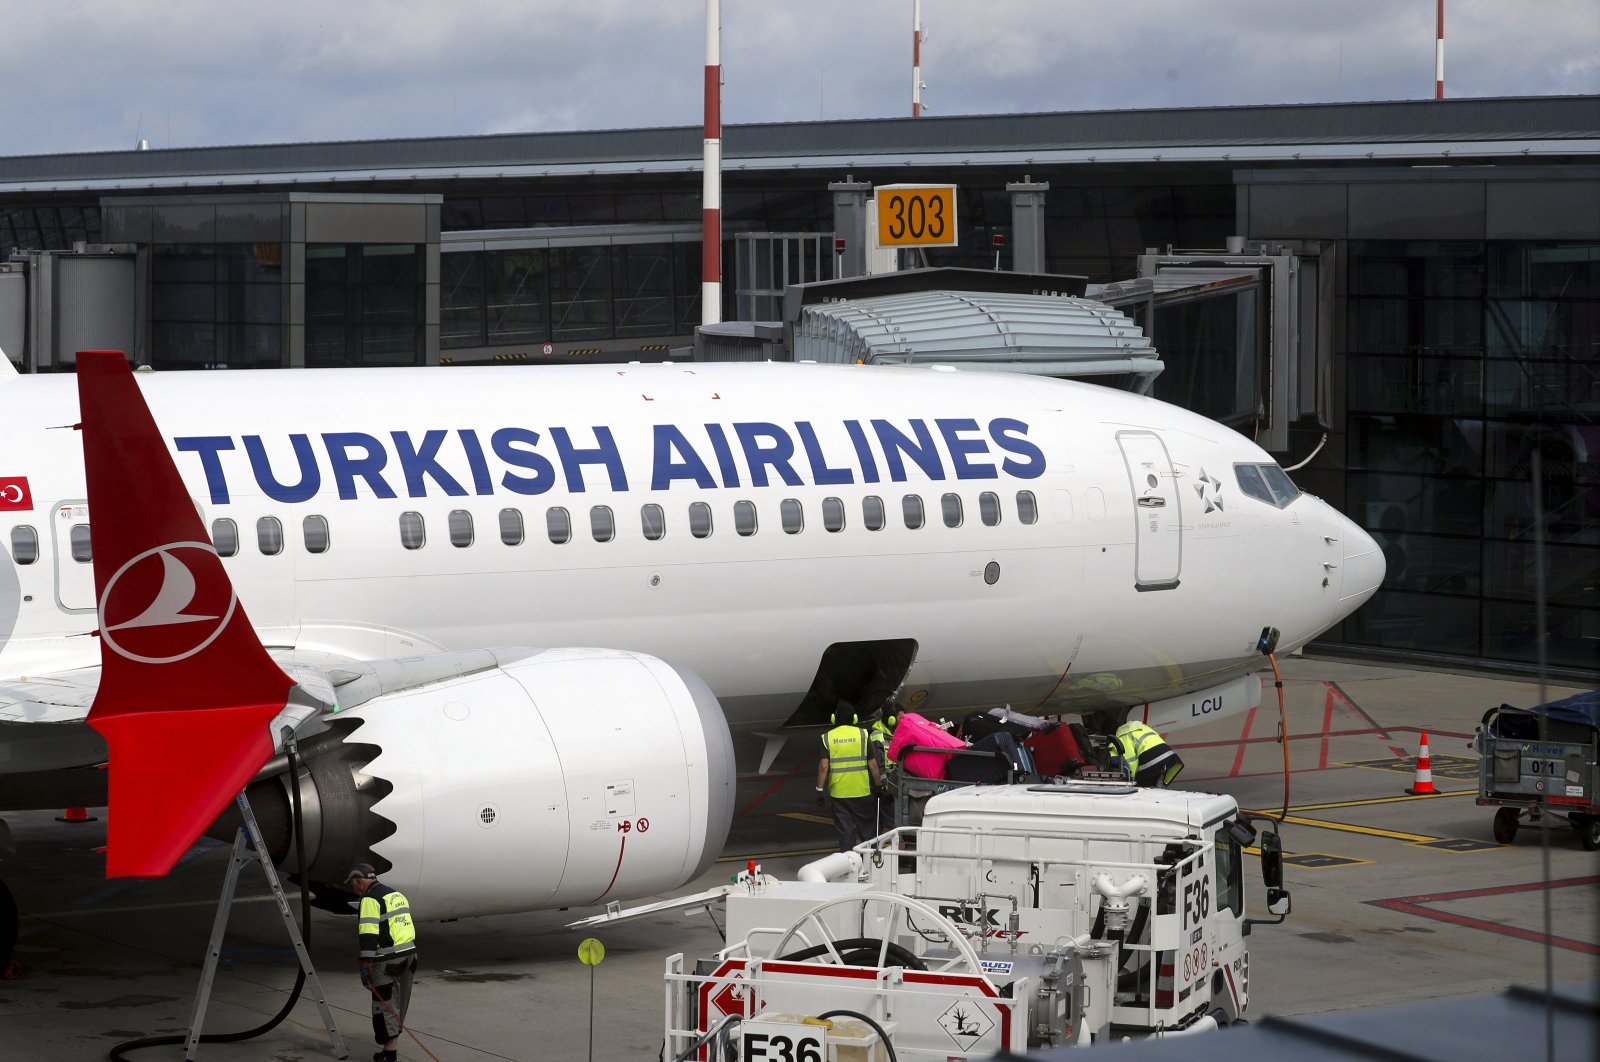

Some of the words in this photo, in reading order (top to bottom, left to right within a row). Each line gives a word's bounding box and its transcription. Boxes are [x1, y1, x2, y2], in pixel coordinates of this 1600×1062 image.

[889, 195, 945, 239] 303
[174, 426, 628, 503] TURKISH
[650, 417, 1047, 491] AIRLINES
[1192, 696, 1222, 717] LCU
[939, 905, 1000, 926] RIX
[1184, 874, 1209, 931] F36
[744, 1033, 822, 1062] F36
